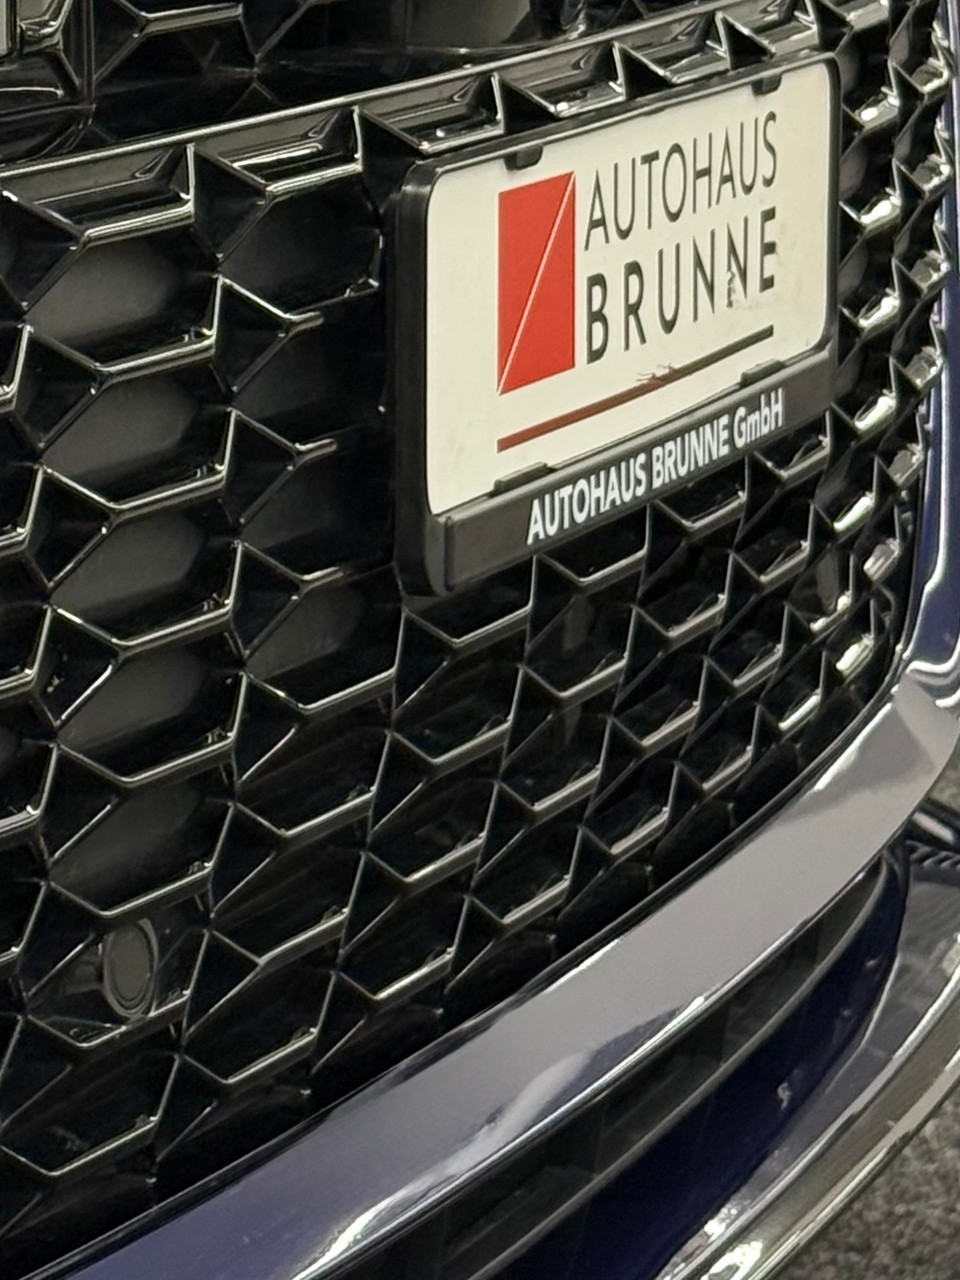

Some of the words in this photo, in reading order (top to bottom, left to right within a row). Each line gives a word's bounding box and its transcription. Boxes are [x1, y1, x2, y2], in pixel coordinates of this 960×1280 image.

[584, 111, 777, 251] AUTOHAUS
[586, 206, 777, 365] BRUNNE
[527, 453, 647, 545] AUTOHAUS
[652, 416, 730, 479] BRUNNE
[733, 387, 784, 449] GmbH
